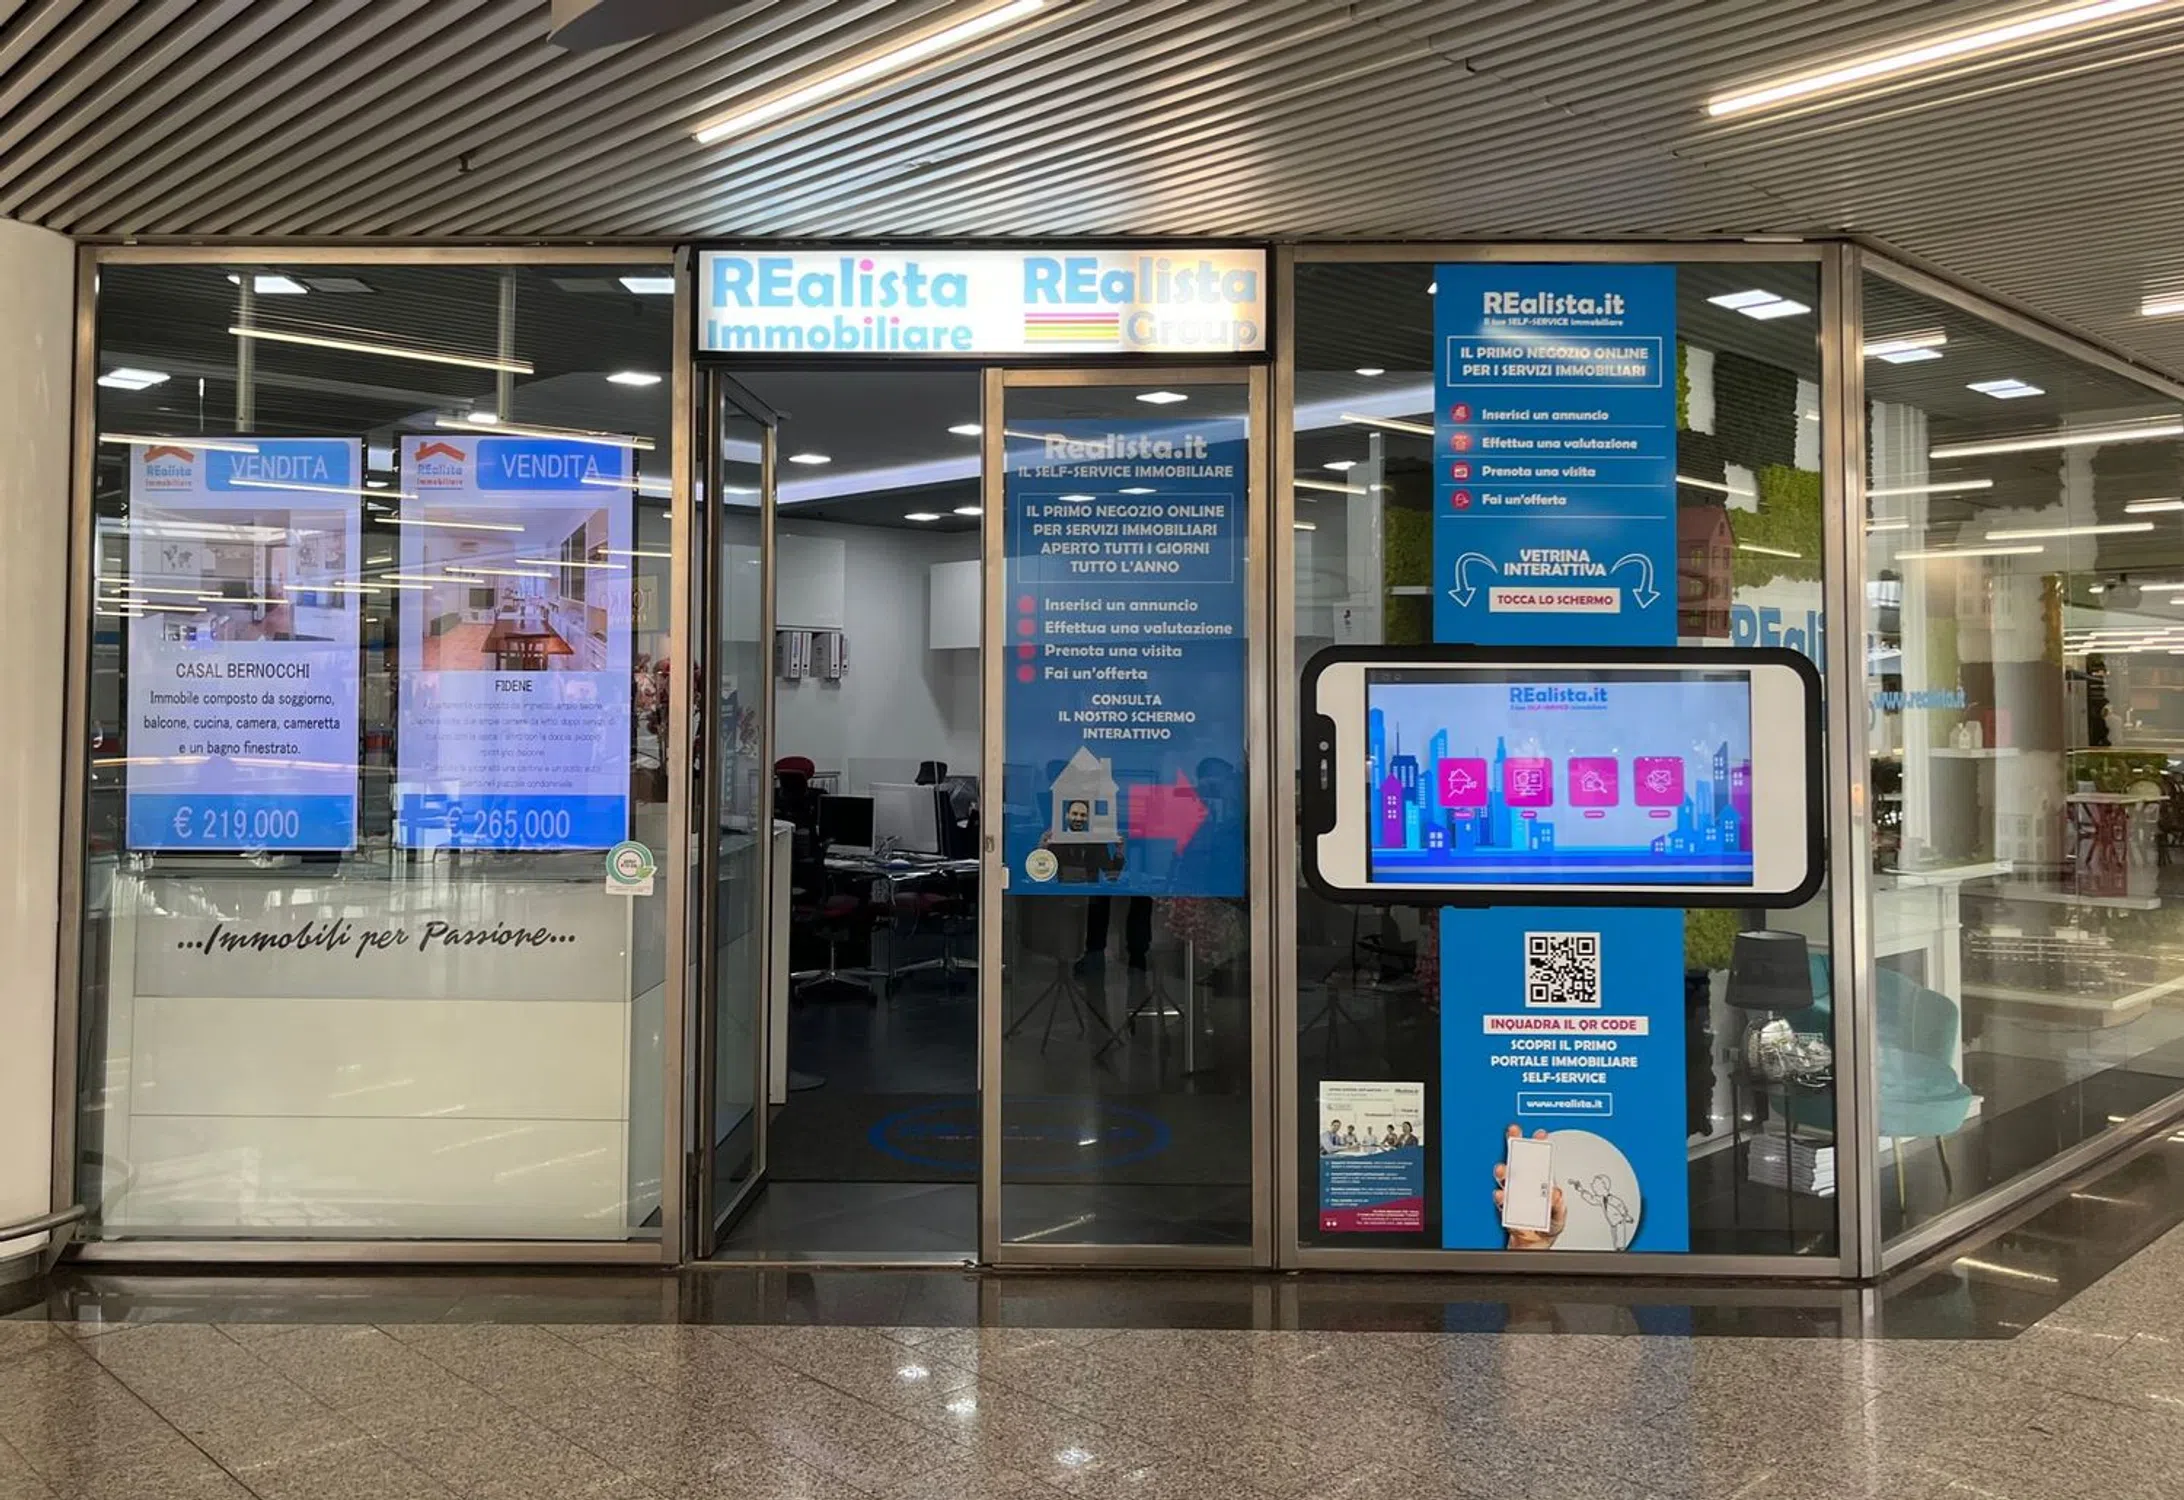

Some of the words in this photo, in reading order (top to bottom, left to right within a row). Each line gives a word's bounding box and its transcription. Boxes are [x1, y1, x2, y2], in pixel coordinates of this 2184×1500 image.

[713, 257, 967, 308] REalista
[1024, 256, 1257, 305] REalista
[1483, 291, 1624, 315] REalista.it
[1508, 317, 1568, 327] SELF-SERVICE
[708, 315, 973, 351] Immobiliare
[1127, 310, 1257, 351] Group
[1461, 347, 1474, 359] IL
[1477, 347, 1524, 359] PRIMO
[1527, 347, 1591, 360] NEGOZIO
[1594, 348, 1649, 360] ONLINE
[1463, 364, 1491, 377] PER
[1494, 364, 1499, 377] I
[1501, 364, 1551, 377] SERVIZI
[1556, 365, 1646, 377] IMMOBILIARI
[1482, 409, 1530, 421] Inserisci
[1533, 412, 1549, 421] un
[1552, 410, 1609, 421] annuncio
[1045, 433, 1208, 460] Realista.it
[1482, 437, 1533, 449] Effettua
[1537, 440, 1560, 449] una
[1564, 438, 1637, 450] valutazione
[231, 455, 328, 479] VENDITA
[502, 455, 600, 478] VENDITA
[1019, 466, 1031, 478] IL
[1035, 465, 1131, 478] SELF-SERVICE
[1135, 465, 1234, 478] IMMOBILIARE
[1482, 466, 1532, 478] Prenota
[1536, 469, 1559, 478] una
[1563, 466, 1596, 478] visita
[1482, 494, 1502, 505] Fai
[1505, 494, 1567, 506] un'offerta
[1027, 506, 1039, 517] IL
[1043, 505, 1092, 517] PRIMO
[1096, 505, 1163, 517] NEGOZIO
[1168, 505, 1224, 517] ONLINE
[1034, 524, 1061, 536] PER
[1066, 524, 1118, 536] SERVIZI
[1123, 524, 1217, 536] IMMOBILIARI
[1041, 543, 1100, 555] APERTO
[1104, 543, 1143, 555] TUTTI
[1148, 543, 1152, 555] I
[1156, 543, 1210, 555] GIORNI
[1520, 550, 1590, 563] VETRINA
[1071, 561, 1117, 573] TUTTO
[1121, 561, 1180, 573] L'ANNO
[1503, 563, 1607, 577] INTERATTIVA
[1045, 599, 1102, 611] Inserisci
[1106, 601, 1125, 611] un
[1129, 599, 1198, 611] annuncio
[1497, 595, 1536, 605] TOCCA
[1539, 595, 1554, 605] LO
[1557, 595, 1613, 606] SCHERMO
[1045, 621, 1106, 634] Effettua
[1111, 625, 1139, 634] una
[1143, 622, 1232, 635] valutazione
[1045, 645, 1104, 657] Prenota
[1109, 647, 1137, 657] una
[1142, 645, 1182, 657] visita
[176, 663, 223, 679] CASAL
[227, 663, 310, 679] BERNOCCHI
[1045, 667, 1068, 679] Fai
[1072, 667, 1148, 680] un'offerta
[495, 680, 533, 692] FIDENE
[150, 691, 199, 705] Immobile
[203, 693, 257, 707] composto
[262, 691, 275, 705] da
[279, 692, 335, 708] soggiorno,
[1092, 695, 1162, 705] CONSULTA
[1510, 687, 1608, 702] REalista.it
[144, 715, 190, 731] balcone,
[194, 716, 232, 731] cucina,
[236, 718, 280, 731] camera,
[284, 717, 340, 730] cameretta
[1059, 711, 1070, 722] IL
[1074, 711, 1128, 722] NOSTRO
[1132, 711, 1196, 722] SCHERMO
[1083, 728, 1171, 740] INTERATTIVO
[179, 744, 185, 754] e
[190, 744, 203, 754] un
[207, 740, 240, 757] bagno
[244, 740, 301, 754] finestrato.
[174, 807, 192, 838] €
[203, 809, 300, 839] 219.000
[448, 807, 464, 837] €
[356, 926, 408, 958] per
[1491, 1019, 1561, 1030] INQUADRA
[1564, 1019, 1576, 1030] IL
[1578, 1019, 1598, 1031] QR
[1601, 1019, 1637, 1030] CODE
[1511, 1040, 1557, 1051] SCOPRI
[1559, 1040, 1571, 1051] IL
[1574, 1040, 1618, 1051] PRIMO
[1491, 1056, 1549, 1067] PORTALE
[1552, 1056, 1639, 1068] IMMOBILIARE
[1523, 1072, 1606, 1084] SELF-SERVICE
[1526, 1099, 1603, 1109] www.realista.it
